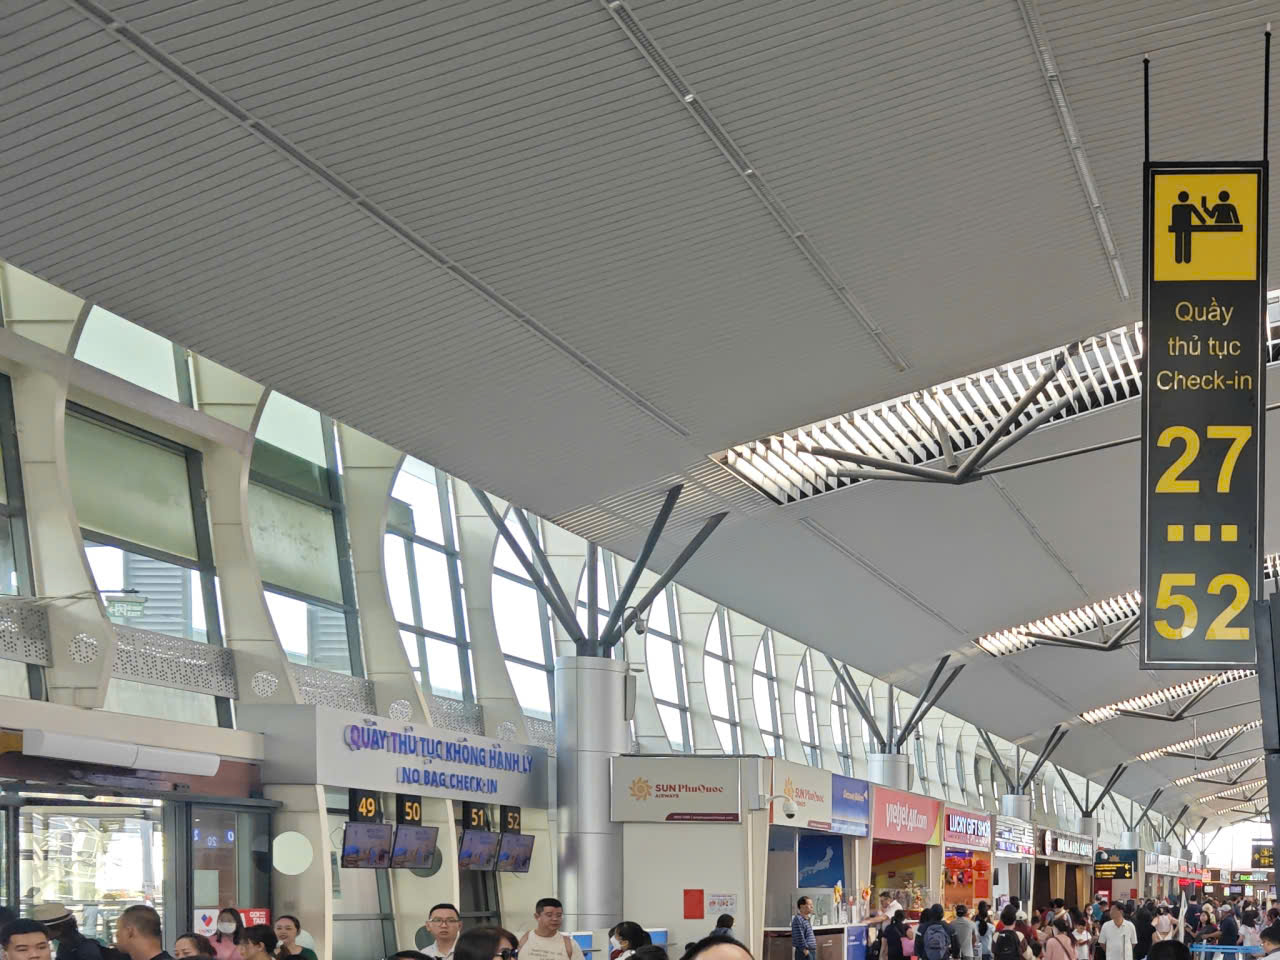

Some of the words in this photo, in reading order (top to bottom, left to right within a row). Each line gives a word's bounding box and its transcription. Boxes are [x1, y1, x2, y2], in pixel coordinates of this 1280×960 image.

[1175, 297, 1233, 327] Quầy
[1168, 334, 1202, 357] thủ
[1208, 337, 1241, 360] tục
[1156, 370, 1252, 391] Check-in
[1154, 425, 1253, 494] 27
[1154, 572, 1251, 641] 52
[402, 767, 420, 784] NO
[423, 770, 445, 787] BAG
[450, 774, 497, 793] CHECK-IN
[655, 784, 676, 793] SUN
[678, 784, 724, 794] PhuQuoc
[358, 797, 376, 816] 49
[405, 802, 420, 820] 50
[471, 809, 484, 826] 51
[507, 812, 520, 829] 52
[949, 814, 966, 834] LUCKY
[966, 818, 978, 836] GIFT
